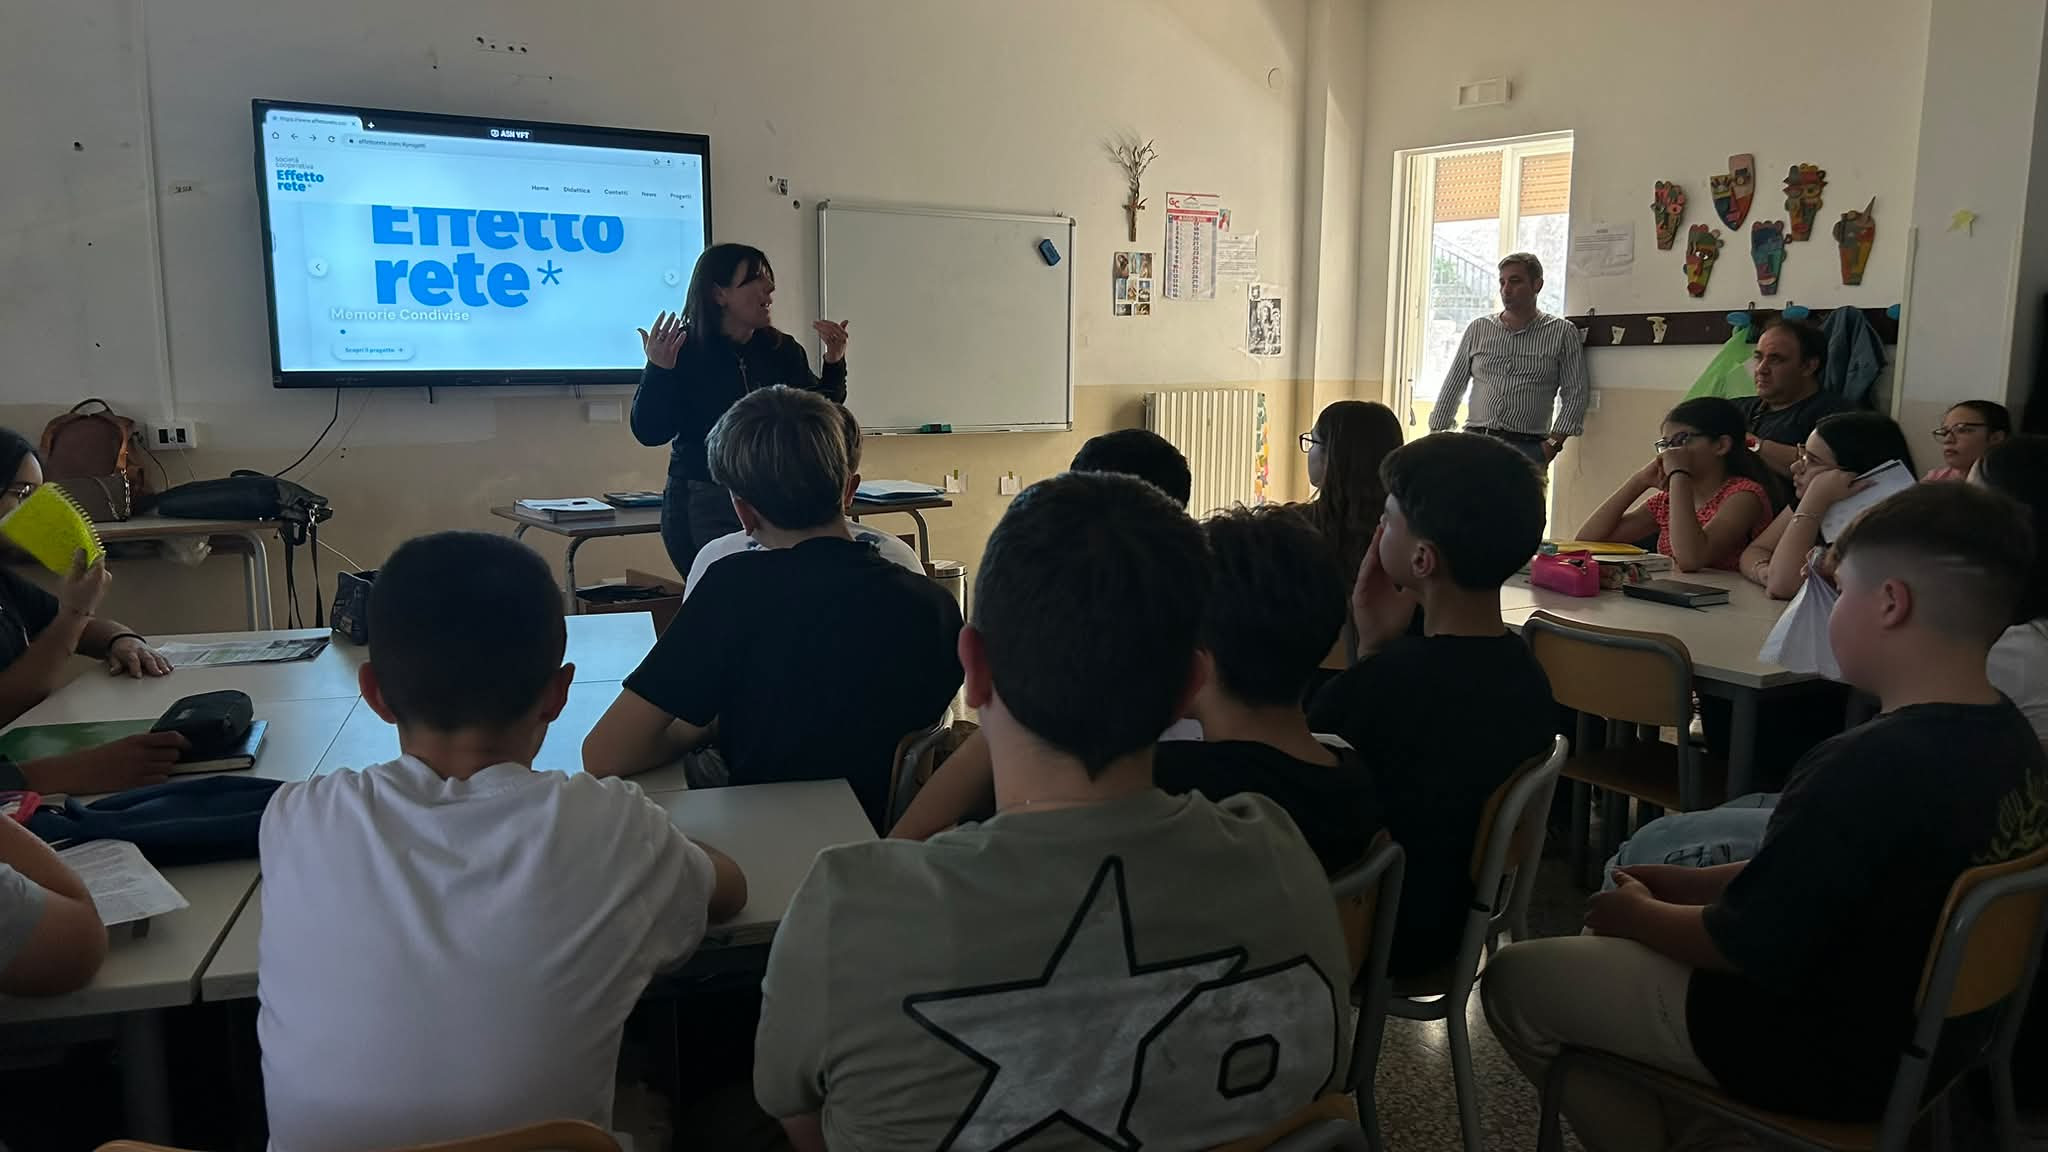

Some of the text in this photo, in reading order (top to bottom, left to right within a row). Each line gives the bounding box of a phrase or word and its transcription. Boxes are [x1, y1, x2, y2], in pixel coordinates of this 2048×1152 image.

[276, 169, 324, 183] Effetto
[563, 186, 590, 194] Didattica
[604, 188, 628, 196] Contatti
[670, 193, 691, 201] Progetti
[372, 205, 624, 254] Effetto
[331, 308, 470, 321] Memorie Condivise
